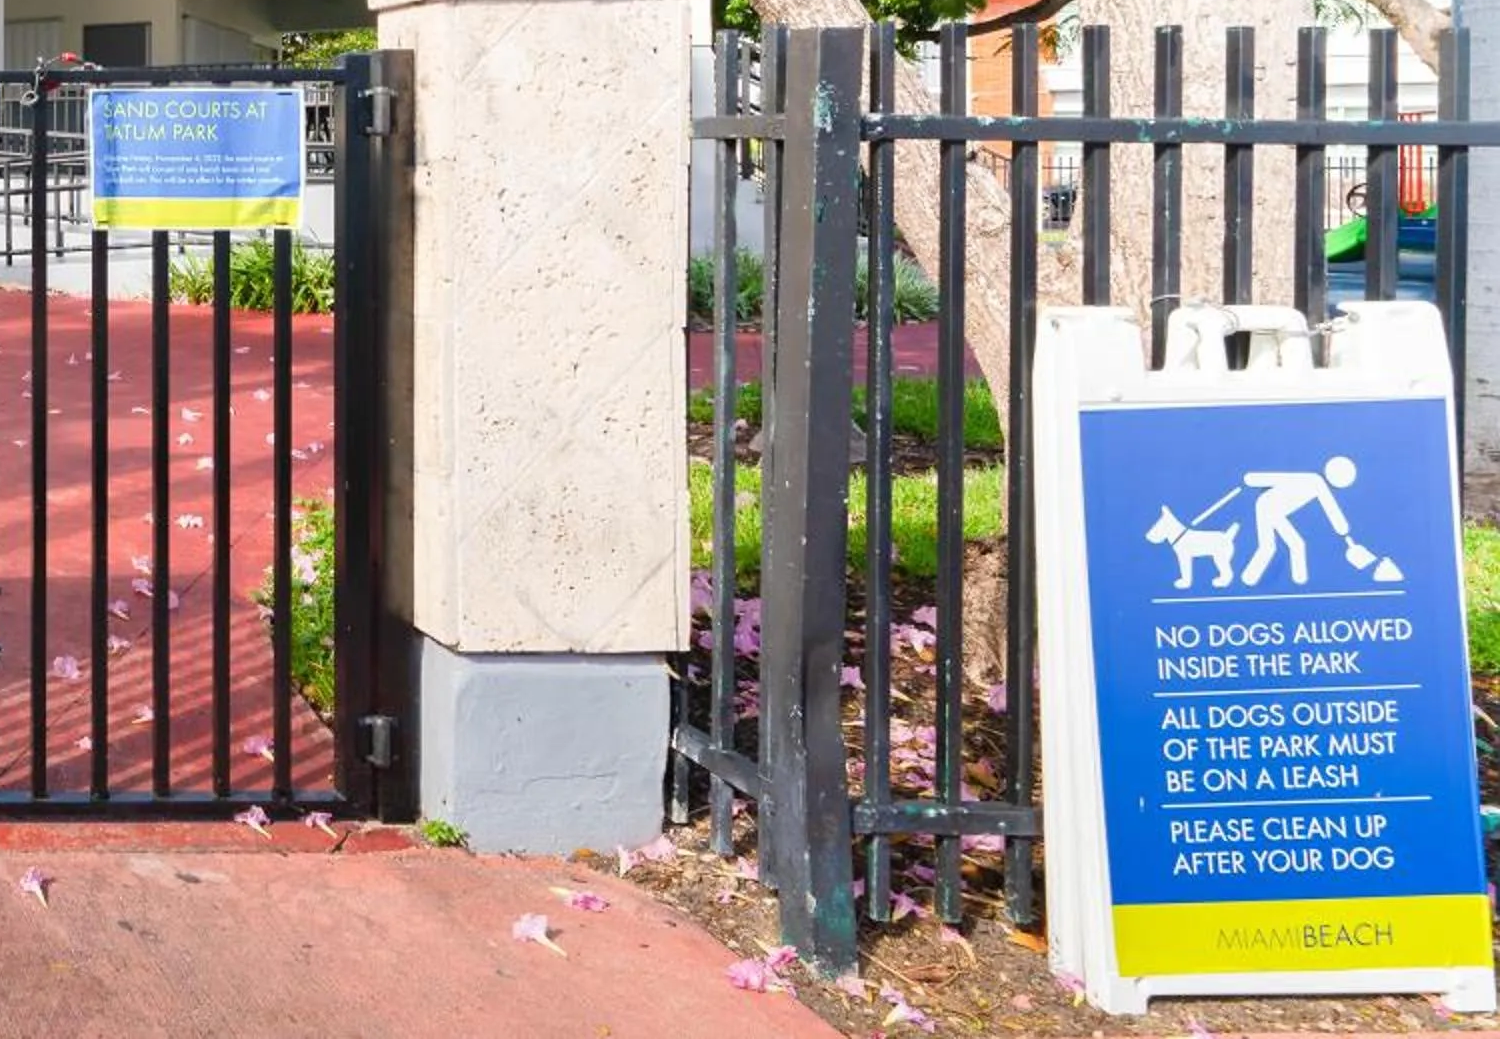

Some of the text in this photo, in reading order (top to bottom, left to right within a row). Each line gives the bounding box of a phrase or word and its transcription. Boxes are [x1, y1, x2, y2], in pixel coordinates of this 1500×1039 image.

[103, 100, 268, 120] SAND COURTS AT
[103, 123, 218, 142] TATUM PARK
[1155, 617, 1412, 648] NO DOGS ALLOWED
[1157, 651, 1362, 680] INSIDE THE PARK
[1161, 700, 1399, 730] ALL DOGS OUTSIDE
[1163, 731, 1398, 762] OF THE PARK MUST
[1166, 764, 1359, 793] BE ON A LEASH
[1170, 814, 1388, 844] PLEASE CLEAN UP
[1173, 846, 1395, 876] AFTER YOUR DOG
[1216, 921, 1394, 950] MIAMIBEACH
